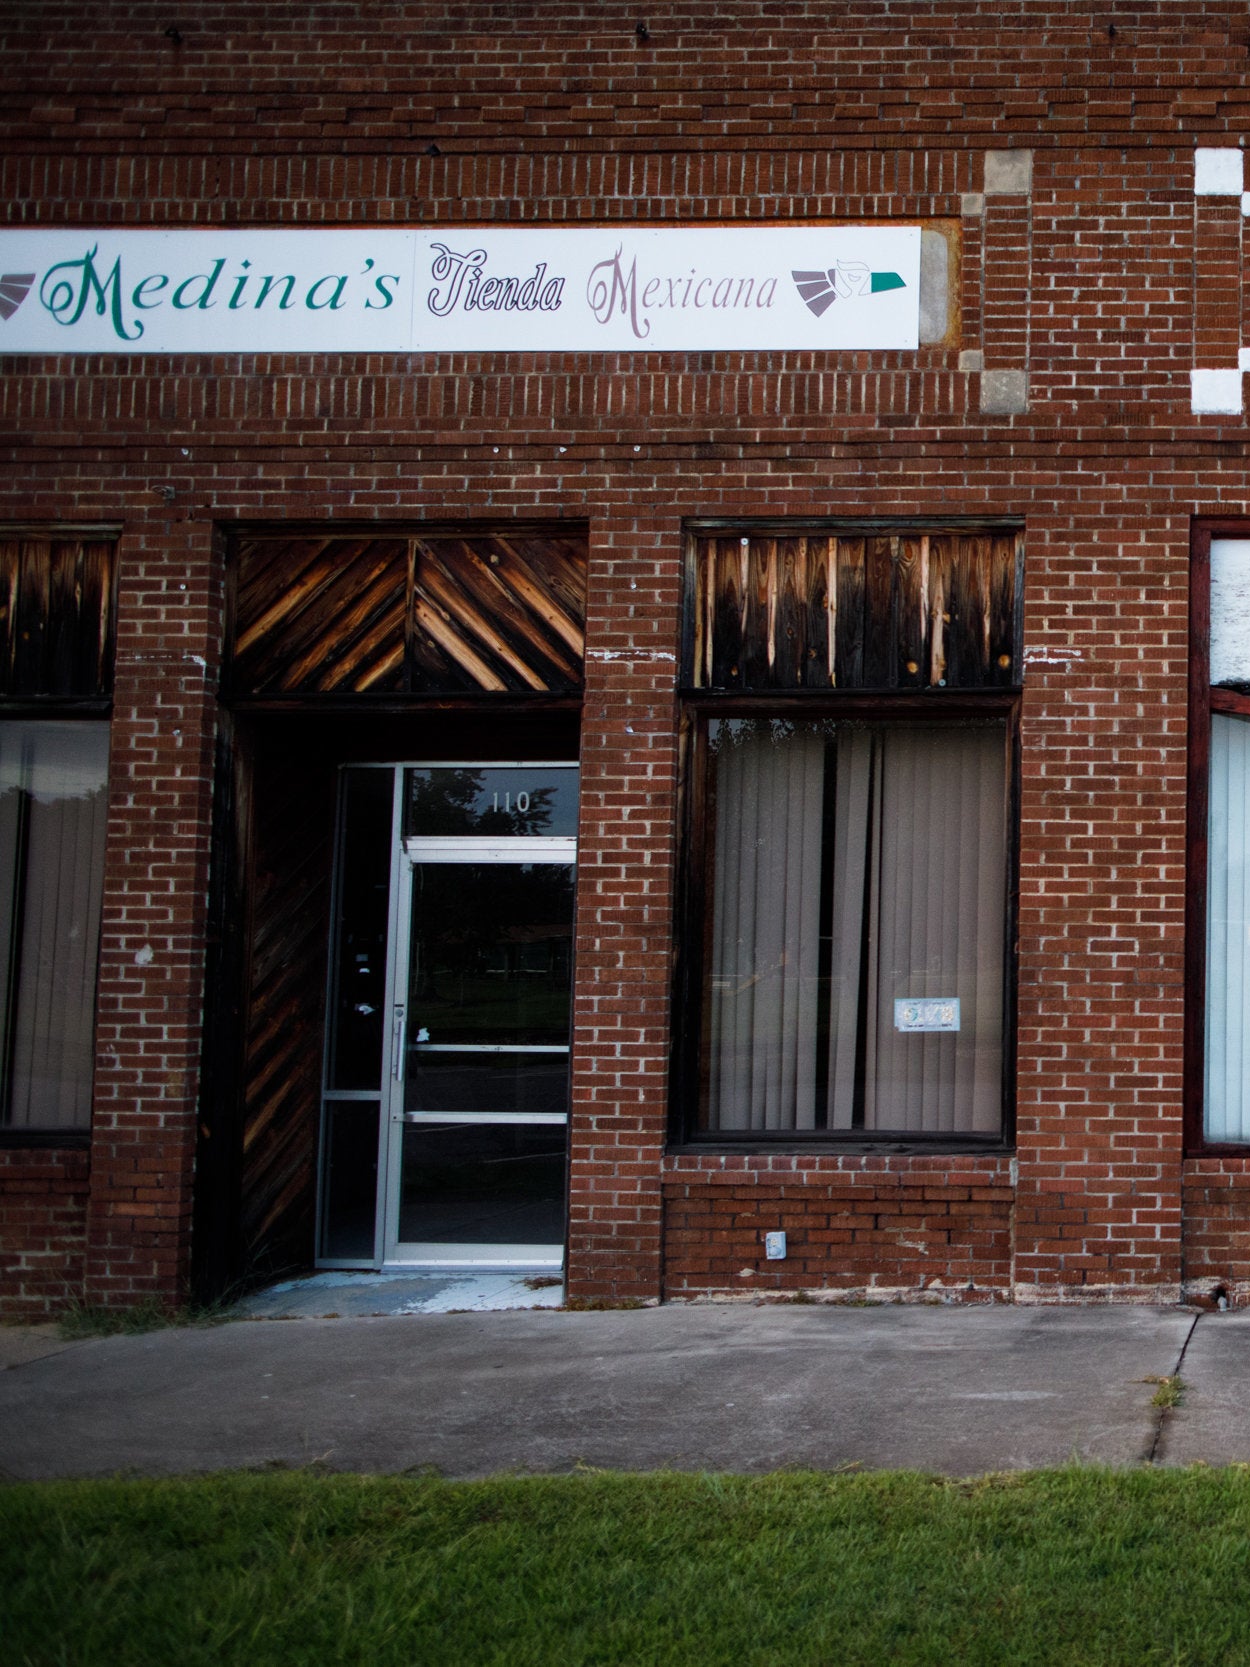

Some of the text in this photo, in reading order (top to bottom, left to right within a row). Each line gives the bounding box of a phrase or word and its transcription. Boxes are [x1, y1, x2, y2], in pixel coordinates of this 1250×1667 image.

[40, 241, 778, 341] Medina's Tienda Mexicana
[493, 791, 530, 812] 110
